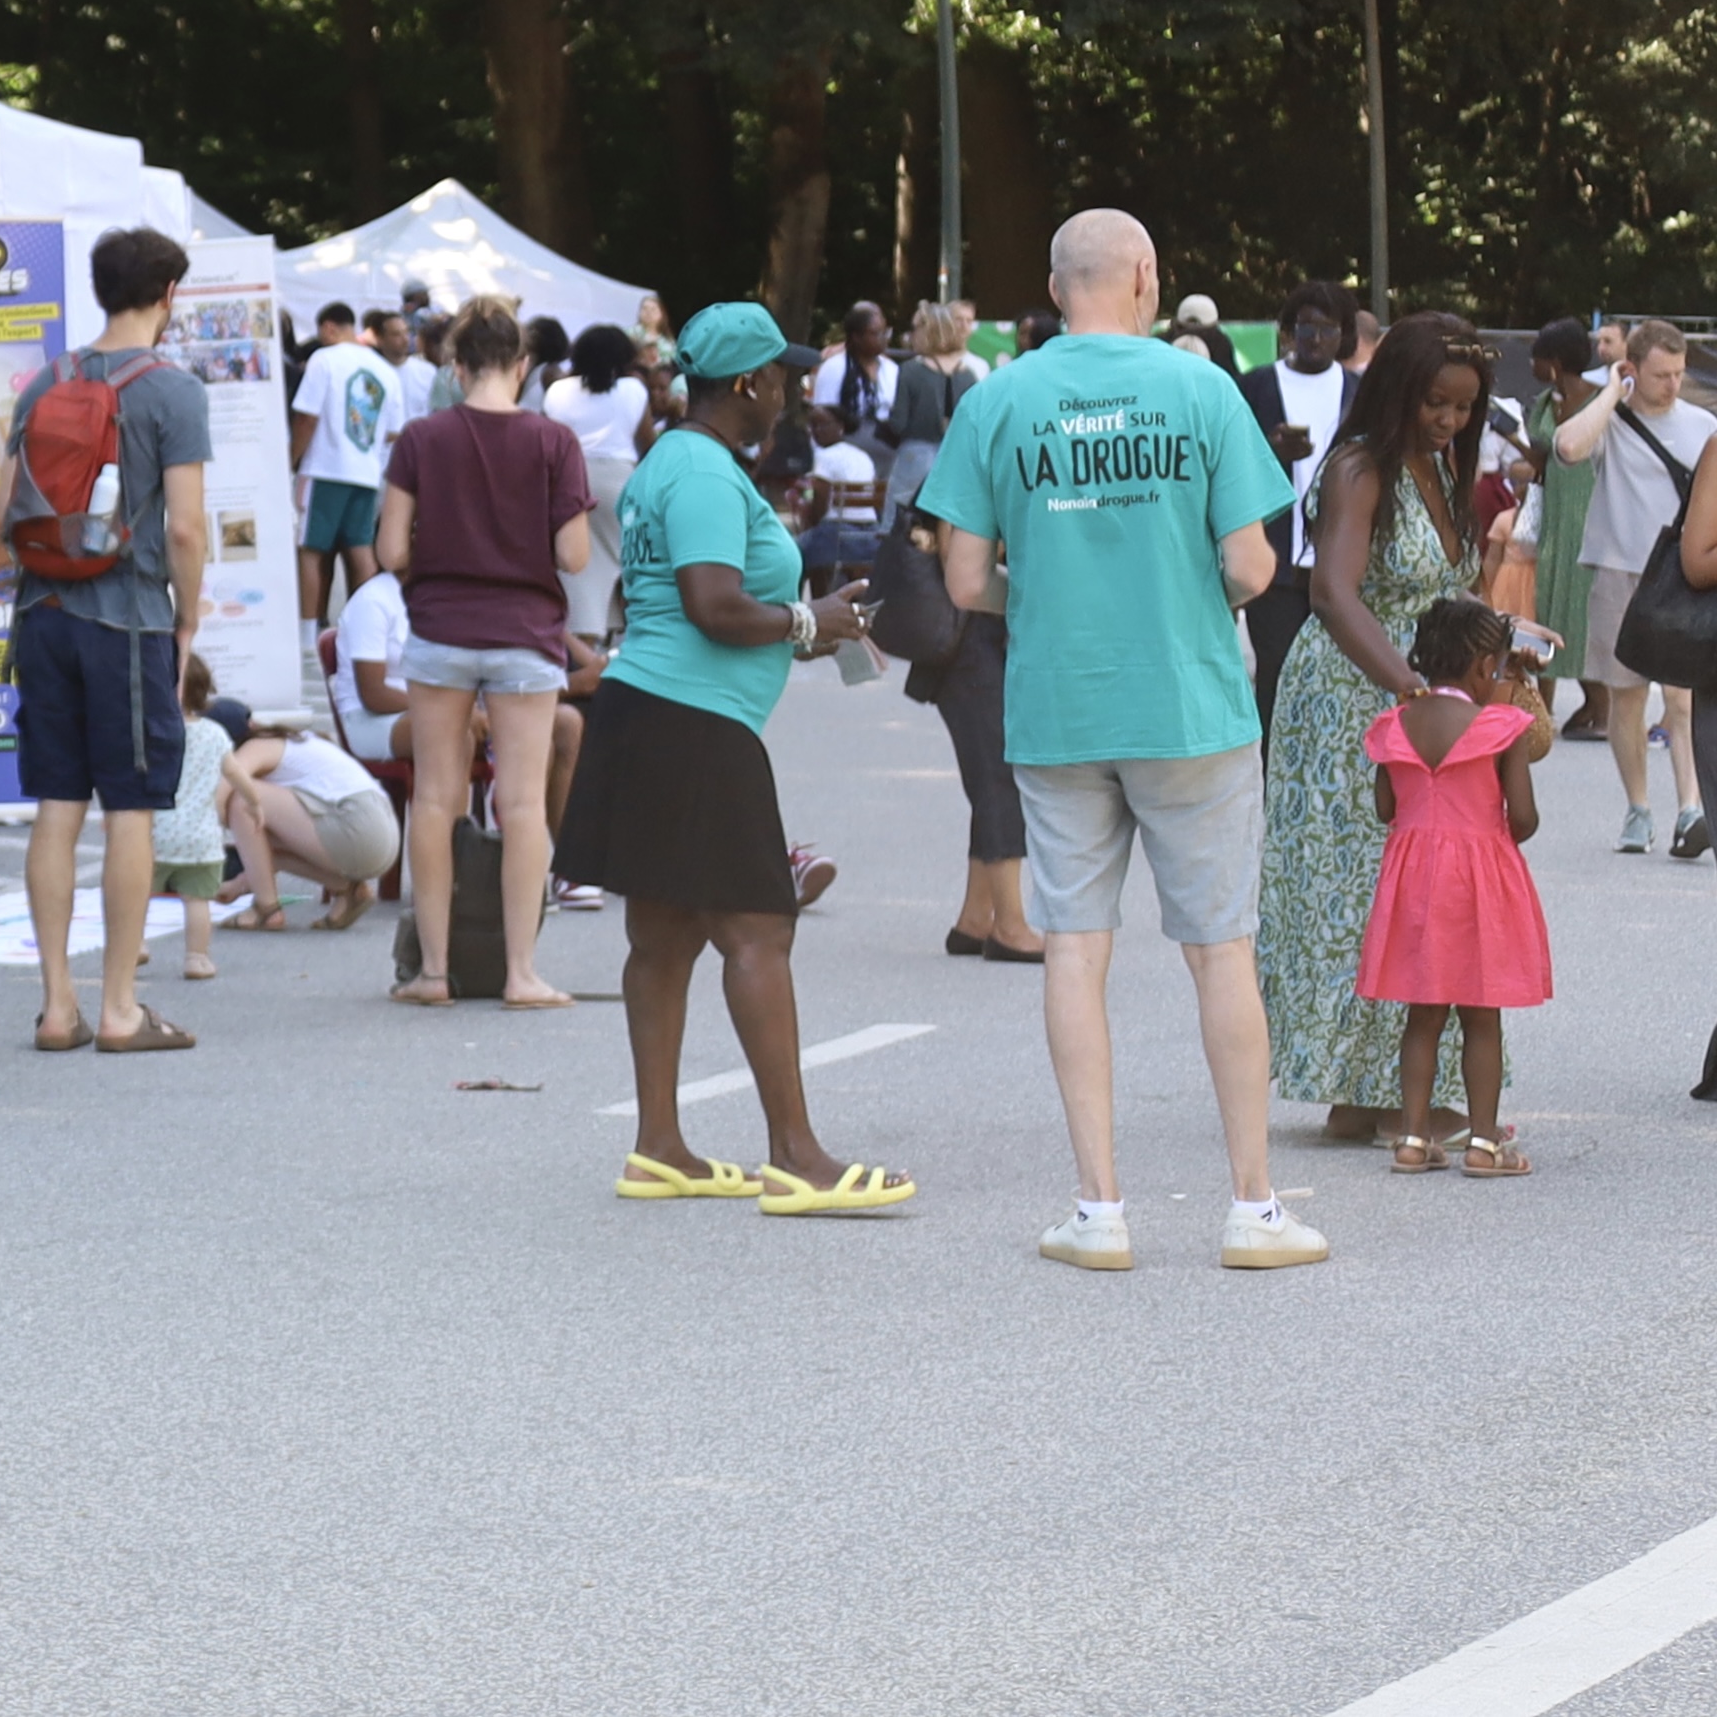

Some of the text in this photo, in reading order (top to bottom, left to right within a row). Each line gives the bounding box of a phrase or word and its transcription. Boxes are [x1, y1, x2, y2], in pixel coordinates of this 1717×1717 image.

[1059, 395, 1138, 412] Découvrez
[1033, 408, 1167, 436] LA VÉRITÉ SUR
[1016, 433, 1191, 492] LA DROGUE
